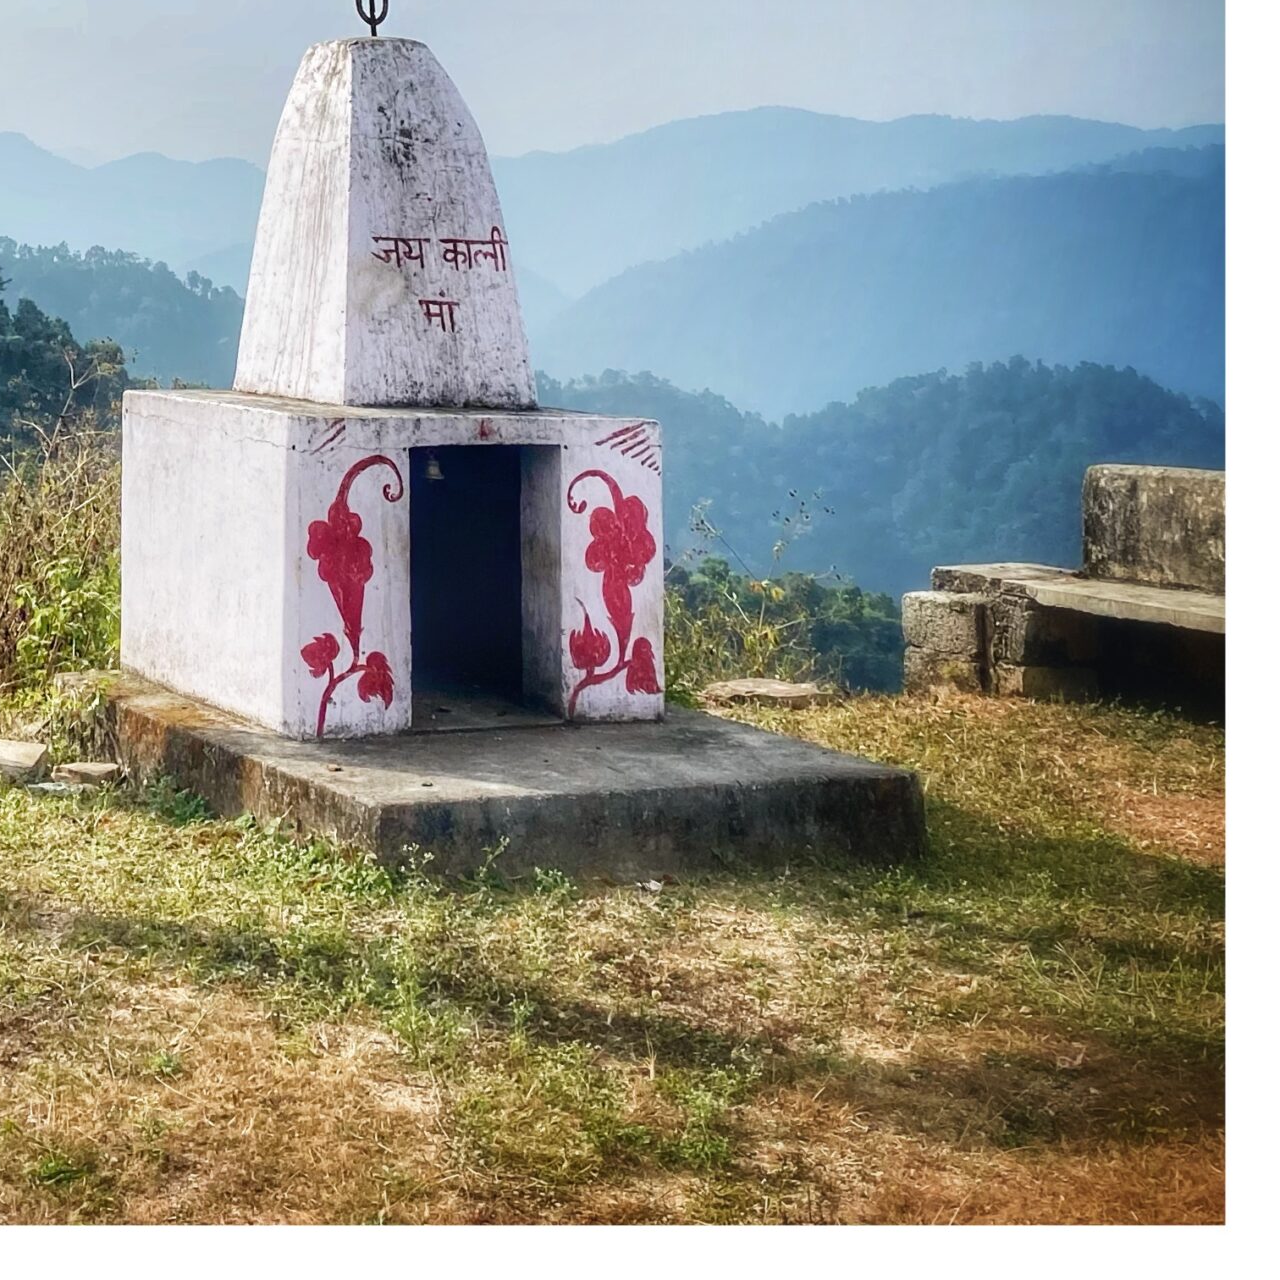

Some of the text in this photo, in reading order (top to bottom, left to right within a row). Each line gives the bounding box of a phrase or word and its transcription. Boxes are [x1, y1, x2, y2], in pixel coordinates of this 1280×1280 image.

[371, 225, 509, 272] जय काली
[418, 289, 461, 333] मां
